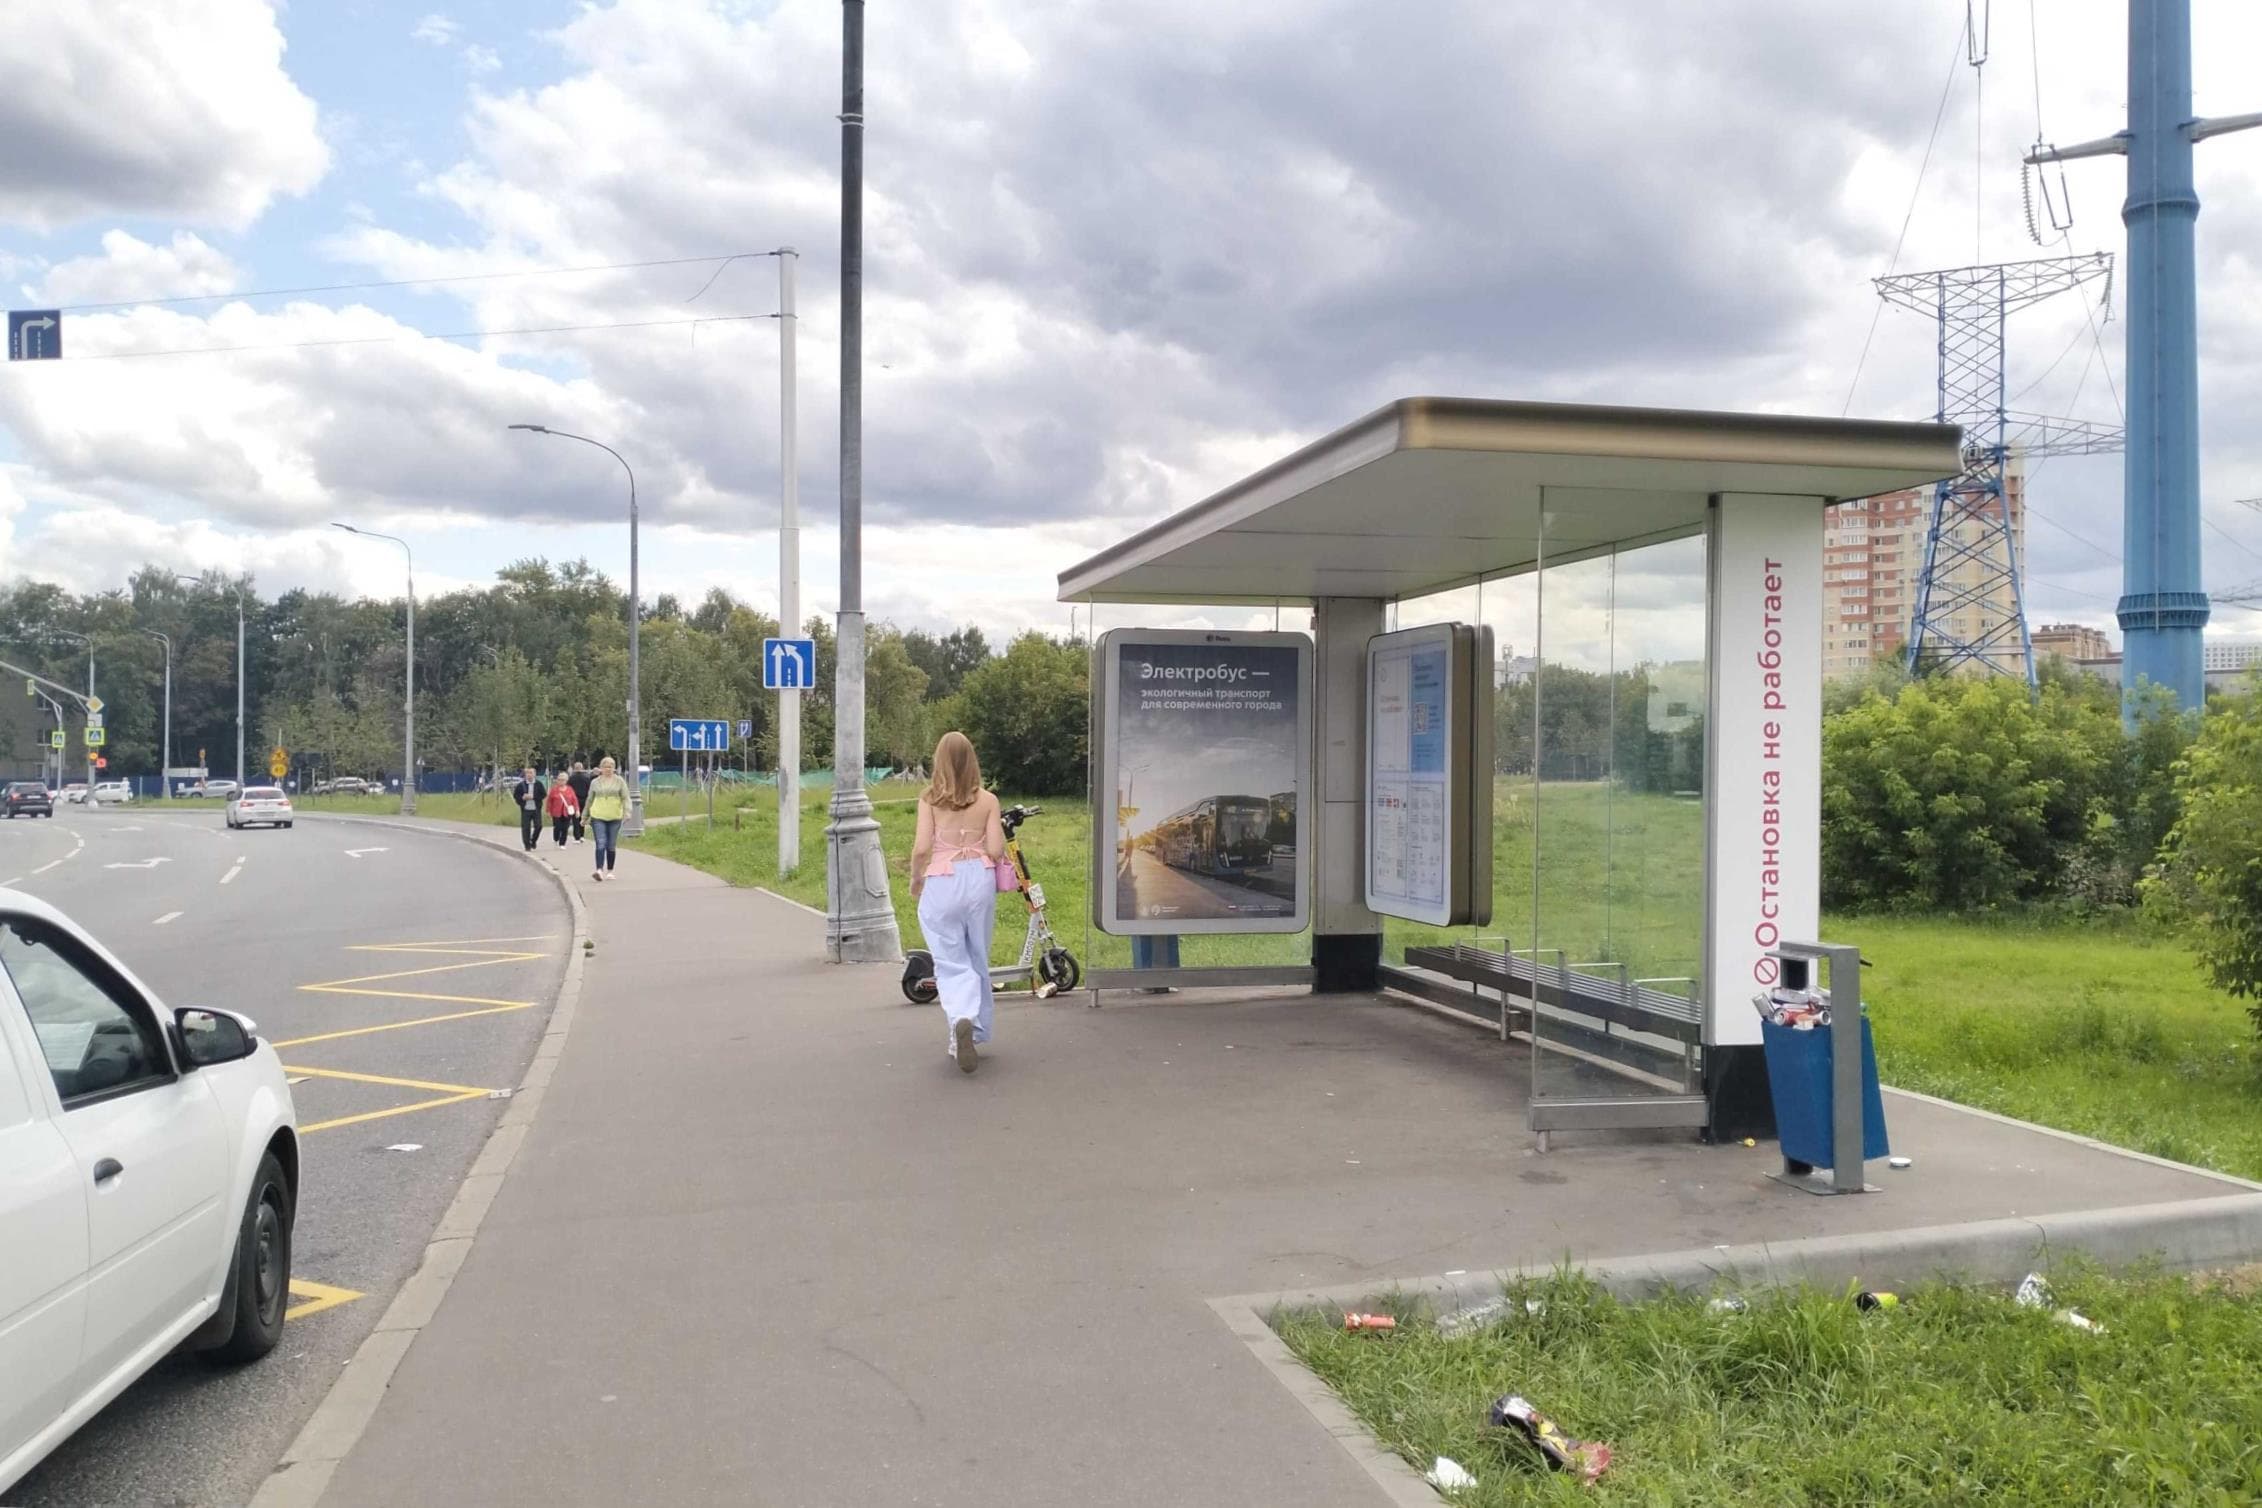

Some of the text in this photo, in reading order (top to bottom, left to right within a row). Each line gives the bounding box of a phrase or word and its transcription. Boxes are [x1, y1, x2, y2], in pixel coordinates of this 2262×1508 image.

[1141, 663, 1247, 683] Электробус
[1141, 688, 1271, 700] экологичный транспорт
[1141, 700, 1282, 711] для современного города
[1754, 558, 1787, 948] Остановка не работает
